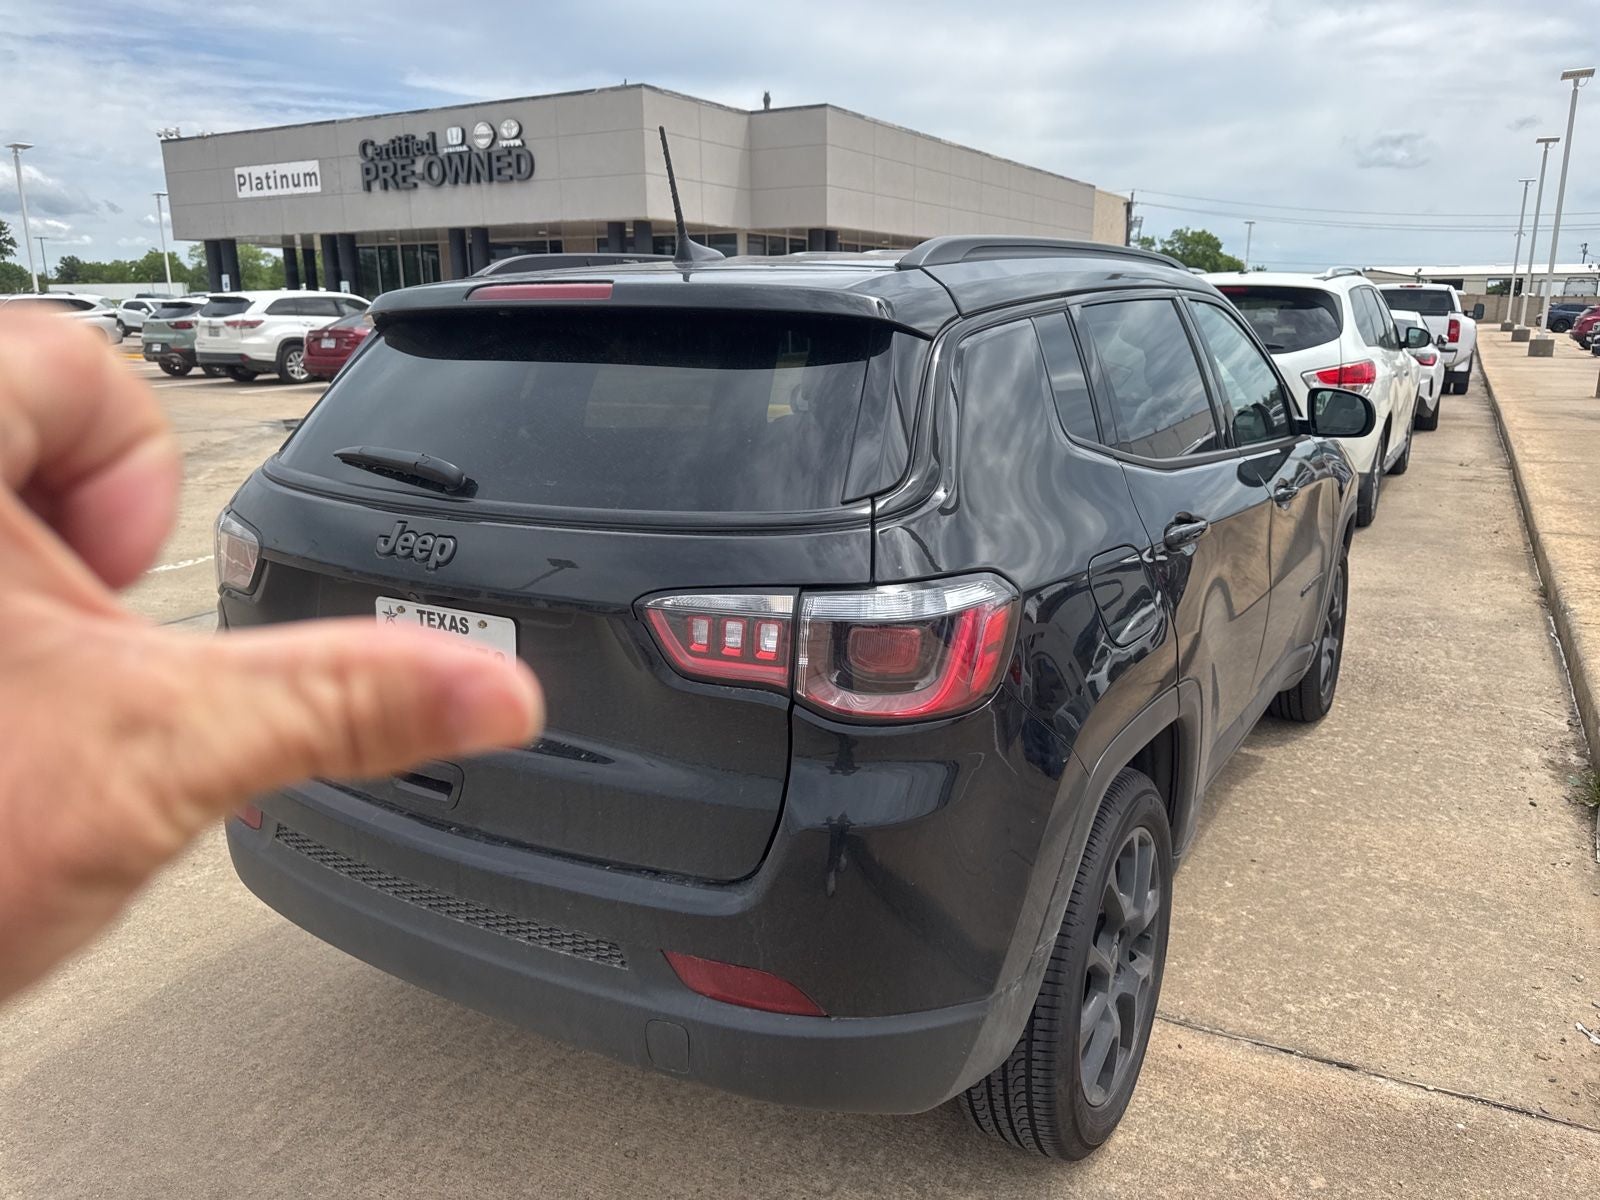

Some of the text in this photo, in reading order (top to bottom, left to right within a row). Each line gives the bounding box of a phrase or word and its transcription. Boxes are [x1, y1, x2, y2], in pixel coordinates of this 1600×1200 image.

[359, 132, 438, 162] Certified
[237, 169, 319, 193] Platinum
[360, 149, 535, 192] PRE-OWNED
[376, 521, 457, 571] Jeep
[416, 609, 470, 635] TEXAS
